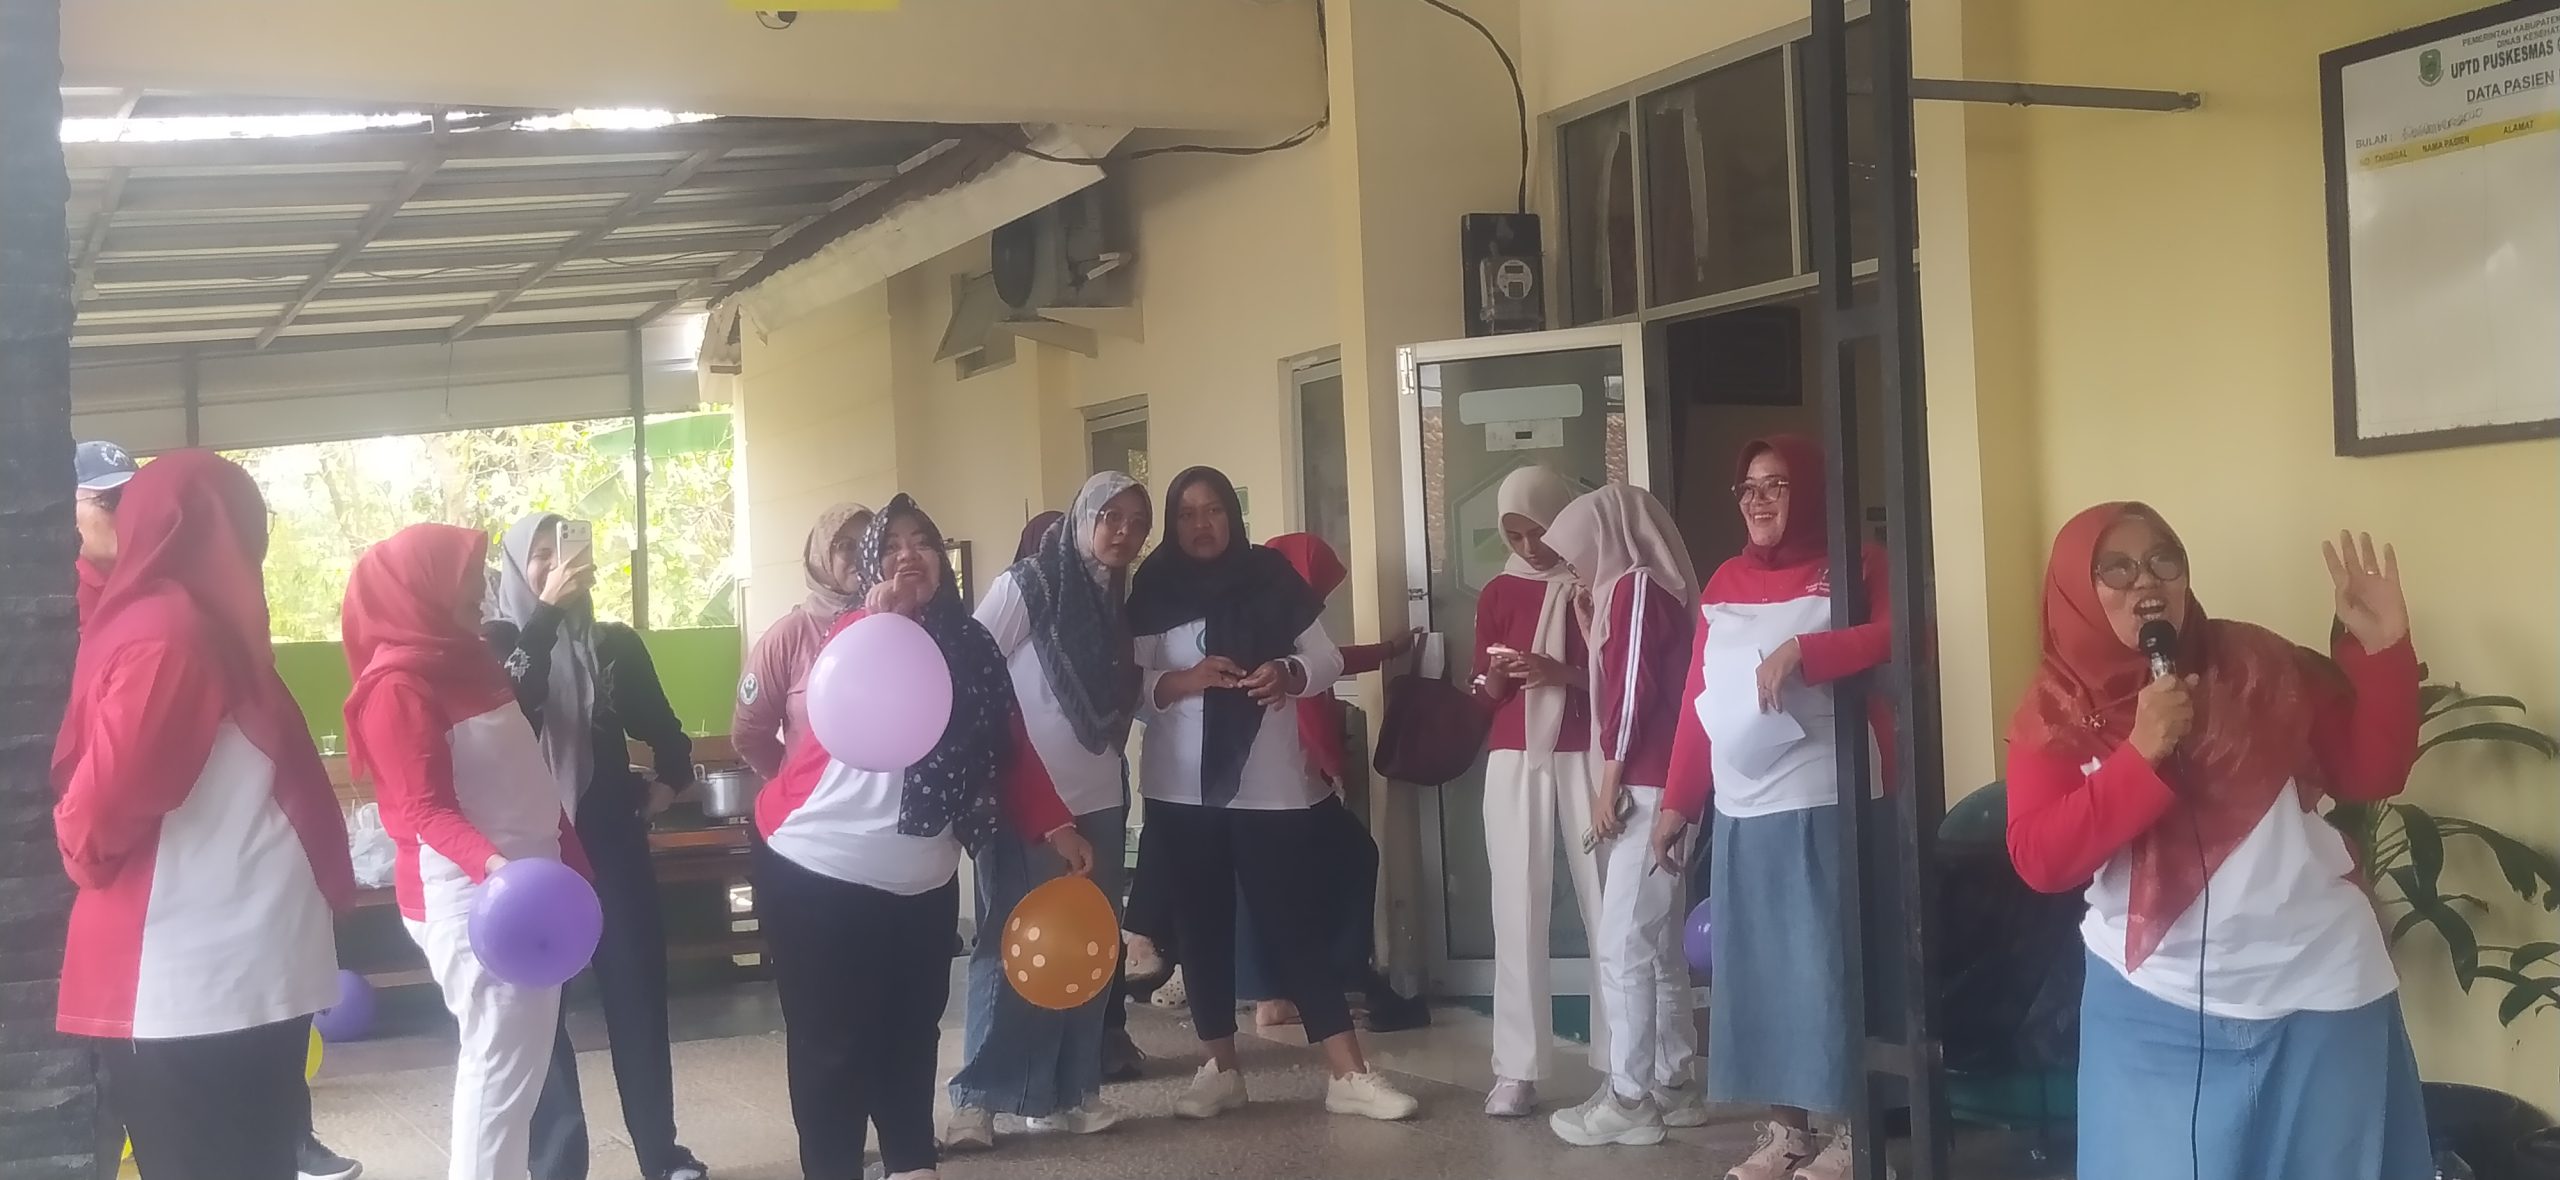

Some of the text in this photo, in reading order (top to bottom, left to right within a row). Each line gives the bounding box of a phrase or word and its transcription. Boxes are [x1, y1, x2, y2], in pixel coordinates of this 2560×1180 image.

[2462, 28, 2513, 47] PEMERINTAH
[2497, 25, 2560, 48] DINAS KESEHAT
[2450, 57, 2480, 79] UPTD
[2483, 39, 2554, 71] PUSKESMAS
[2466, 70, 2555, 103] DATA PASIEN
[2355, 133, 2388, 149] BULAN
[2422, 139, 2443, 153] NAMA
[2503, 120, 2535, 135] ALAMAT
